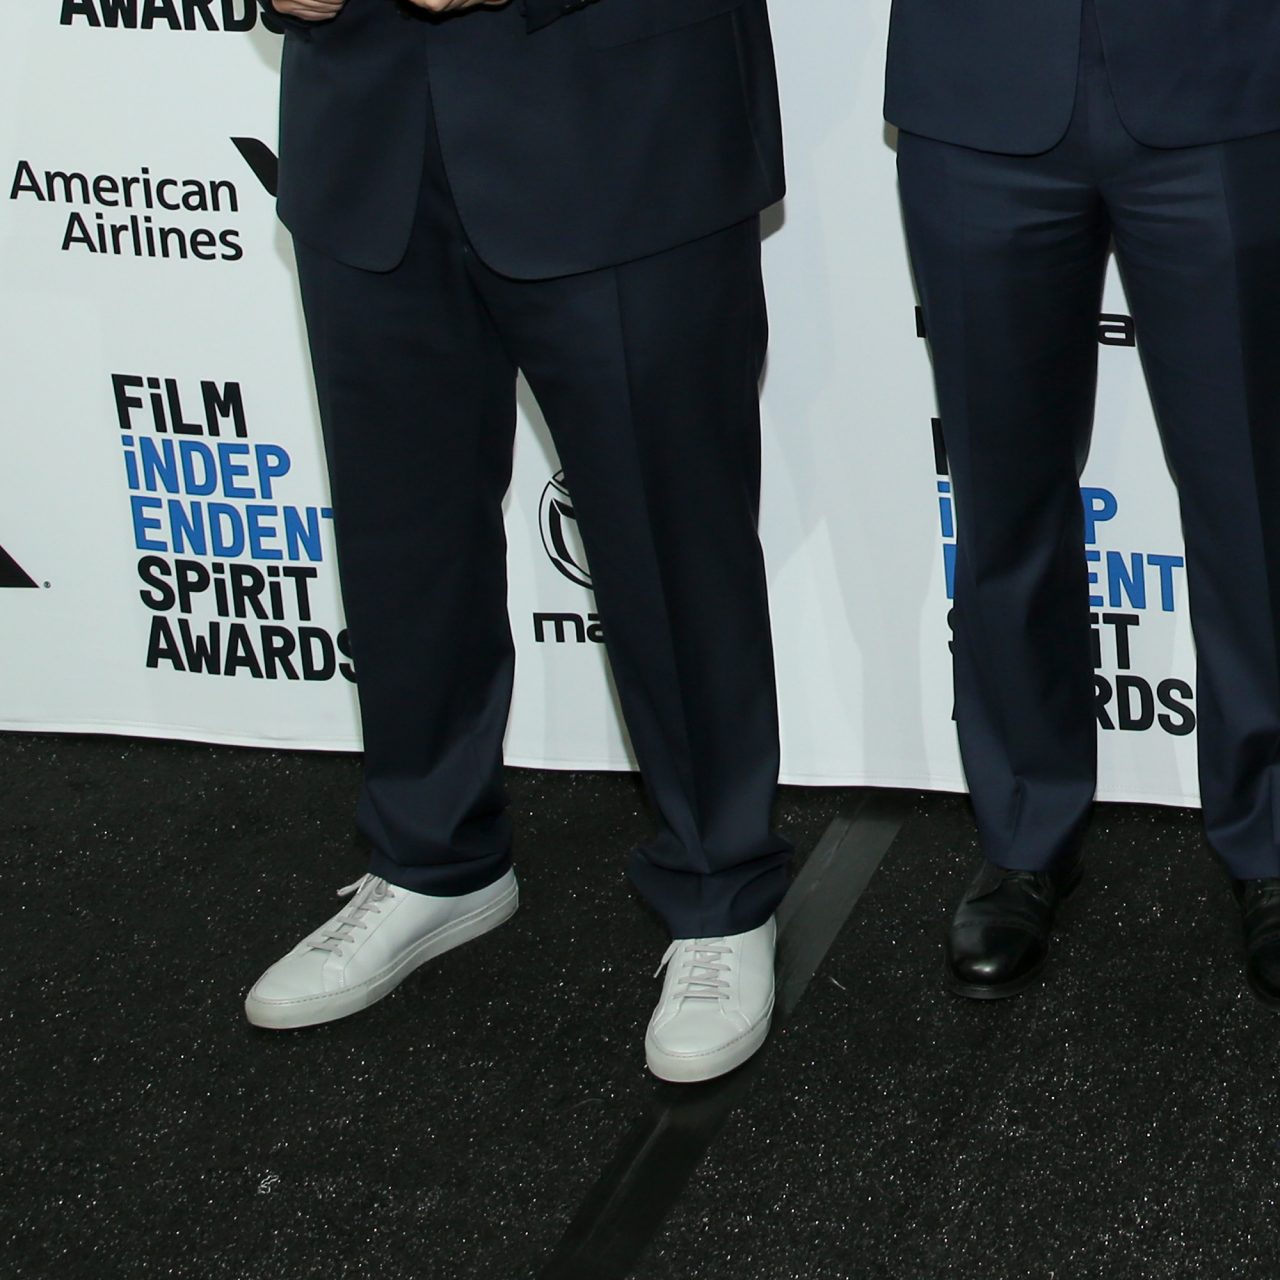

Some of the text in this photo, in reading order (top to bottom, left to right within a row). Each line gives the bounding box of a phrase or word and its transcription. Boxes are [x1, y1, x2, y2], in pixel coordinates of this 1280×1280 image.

[9, 160, 240, 213] American
[61, 211, 244, 262] Airlines
[111, 372, 249, 439] FiLM
[121, 434, 292, 500] iNDEP
[130, 495, 335, 562] ENDEN
[137, 554, 318, 622] SPiRiT
